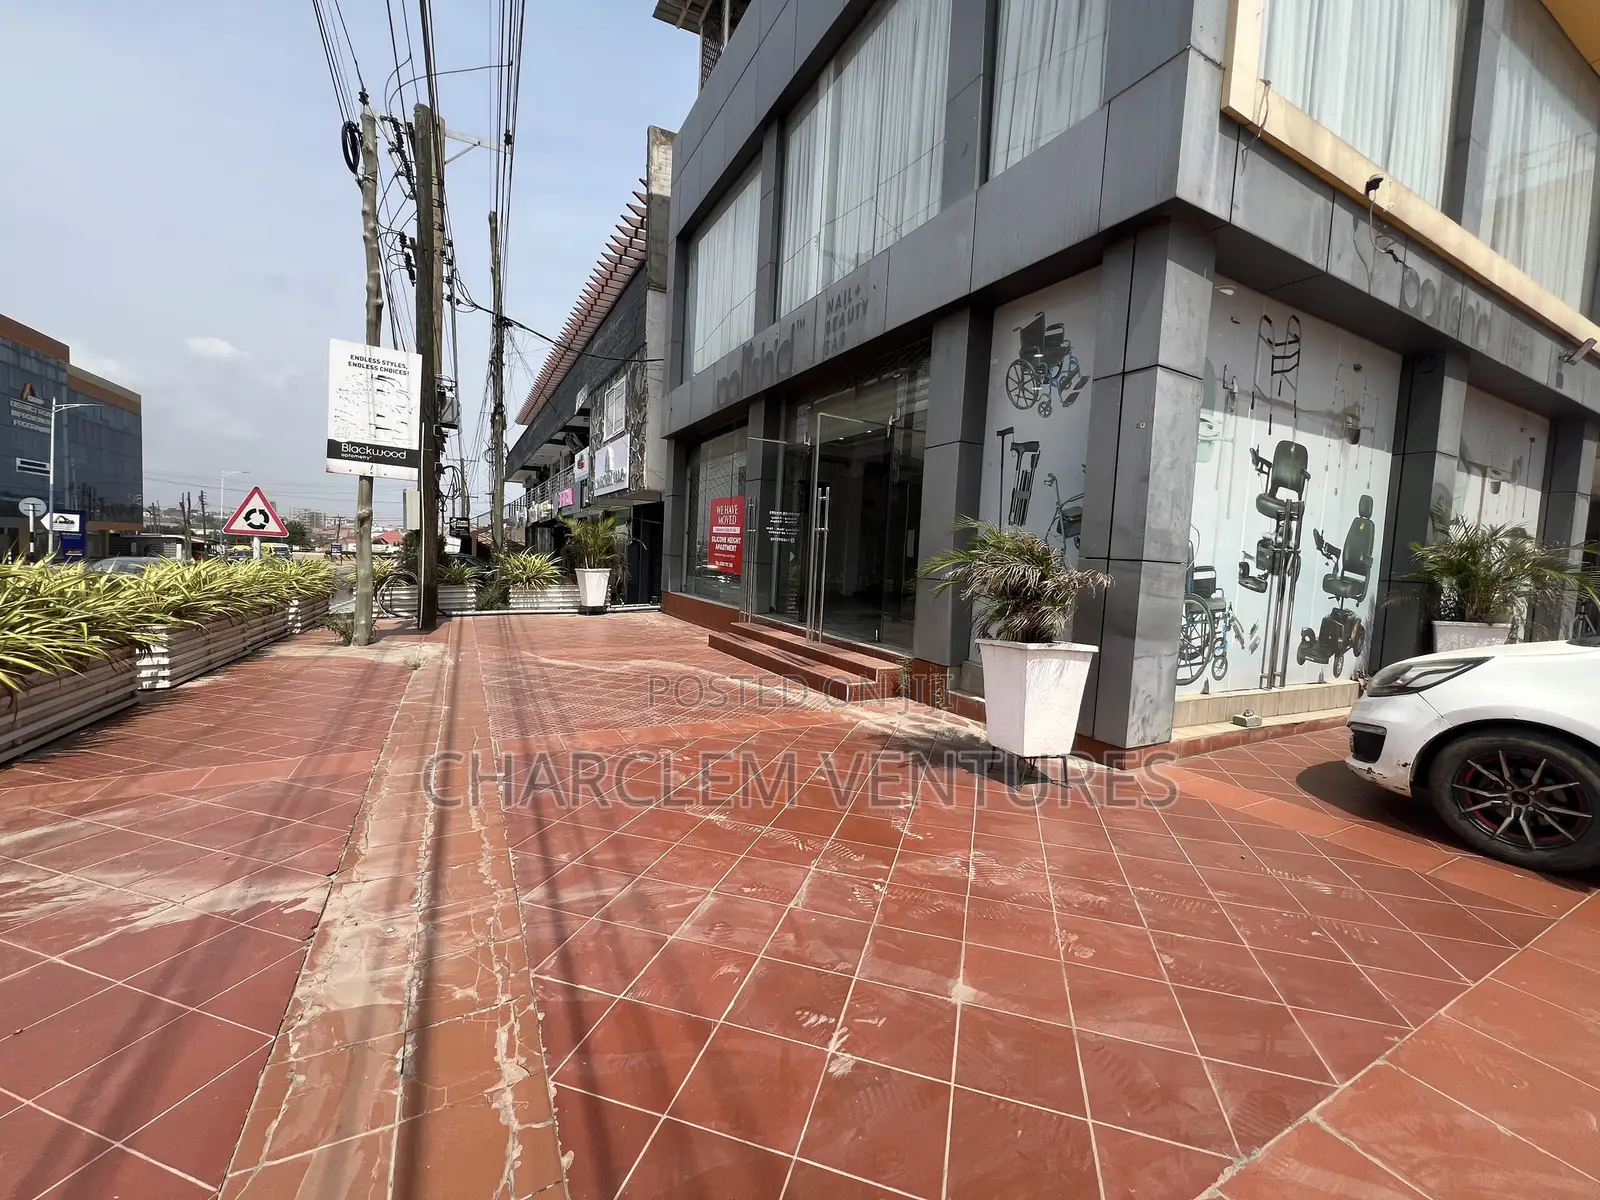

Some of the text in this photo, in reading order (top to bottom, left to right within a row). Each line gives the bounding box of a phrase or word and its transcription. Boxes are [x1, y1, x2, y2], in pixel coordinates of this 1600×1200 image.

[826, 288, 852, 316] NAIL
[348, 361, 410, 376] ENDLESS CHOICES!
[350, 354, 408, 370] ENDLESS STYLES,
[341, 442, 407, 460] Blackwood
[716, 504, 739, 515] WE HAVE
[717, 514, 737, 525] MOVED
